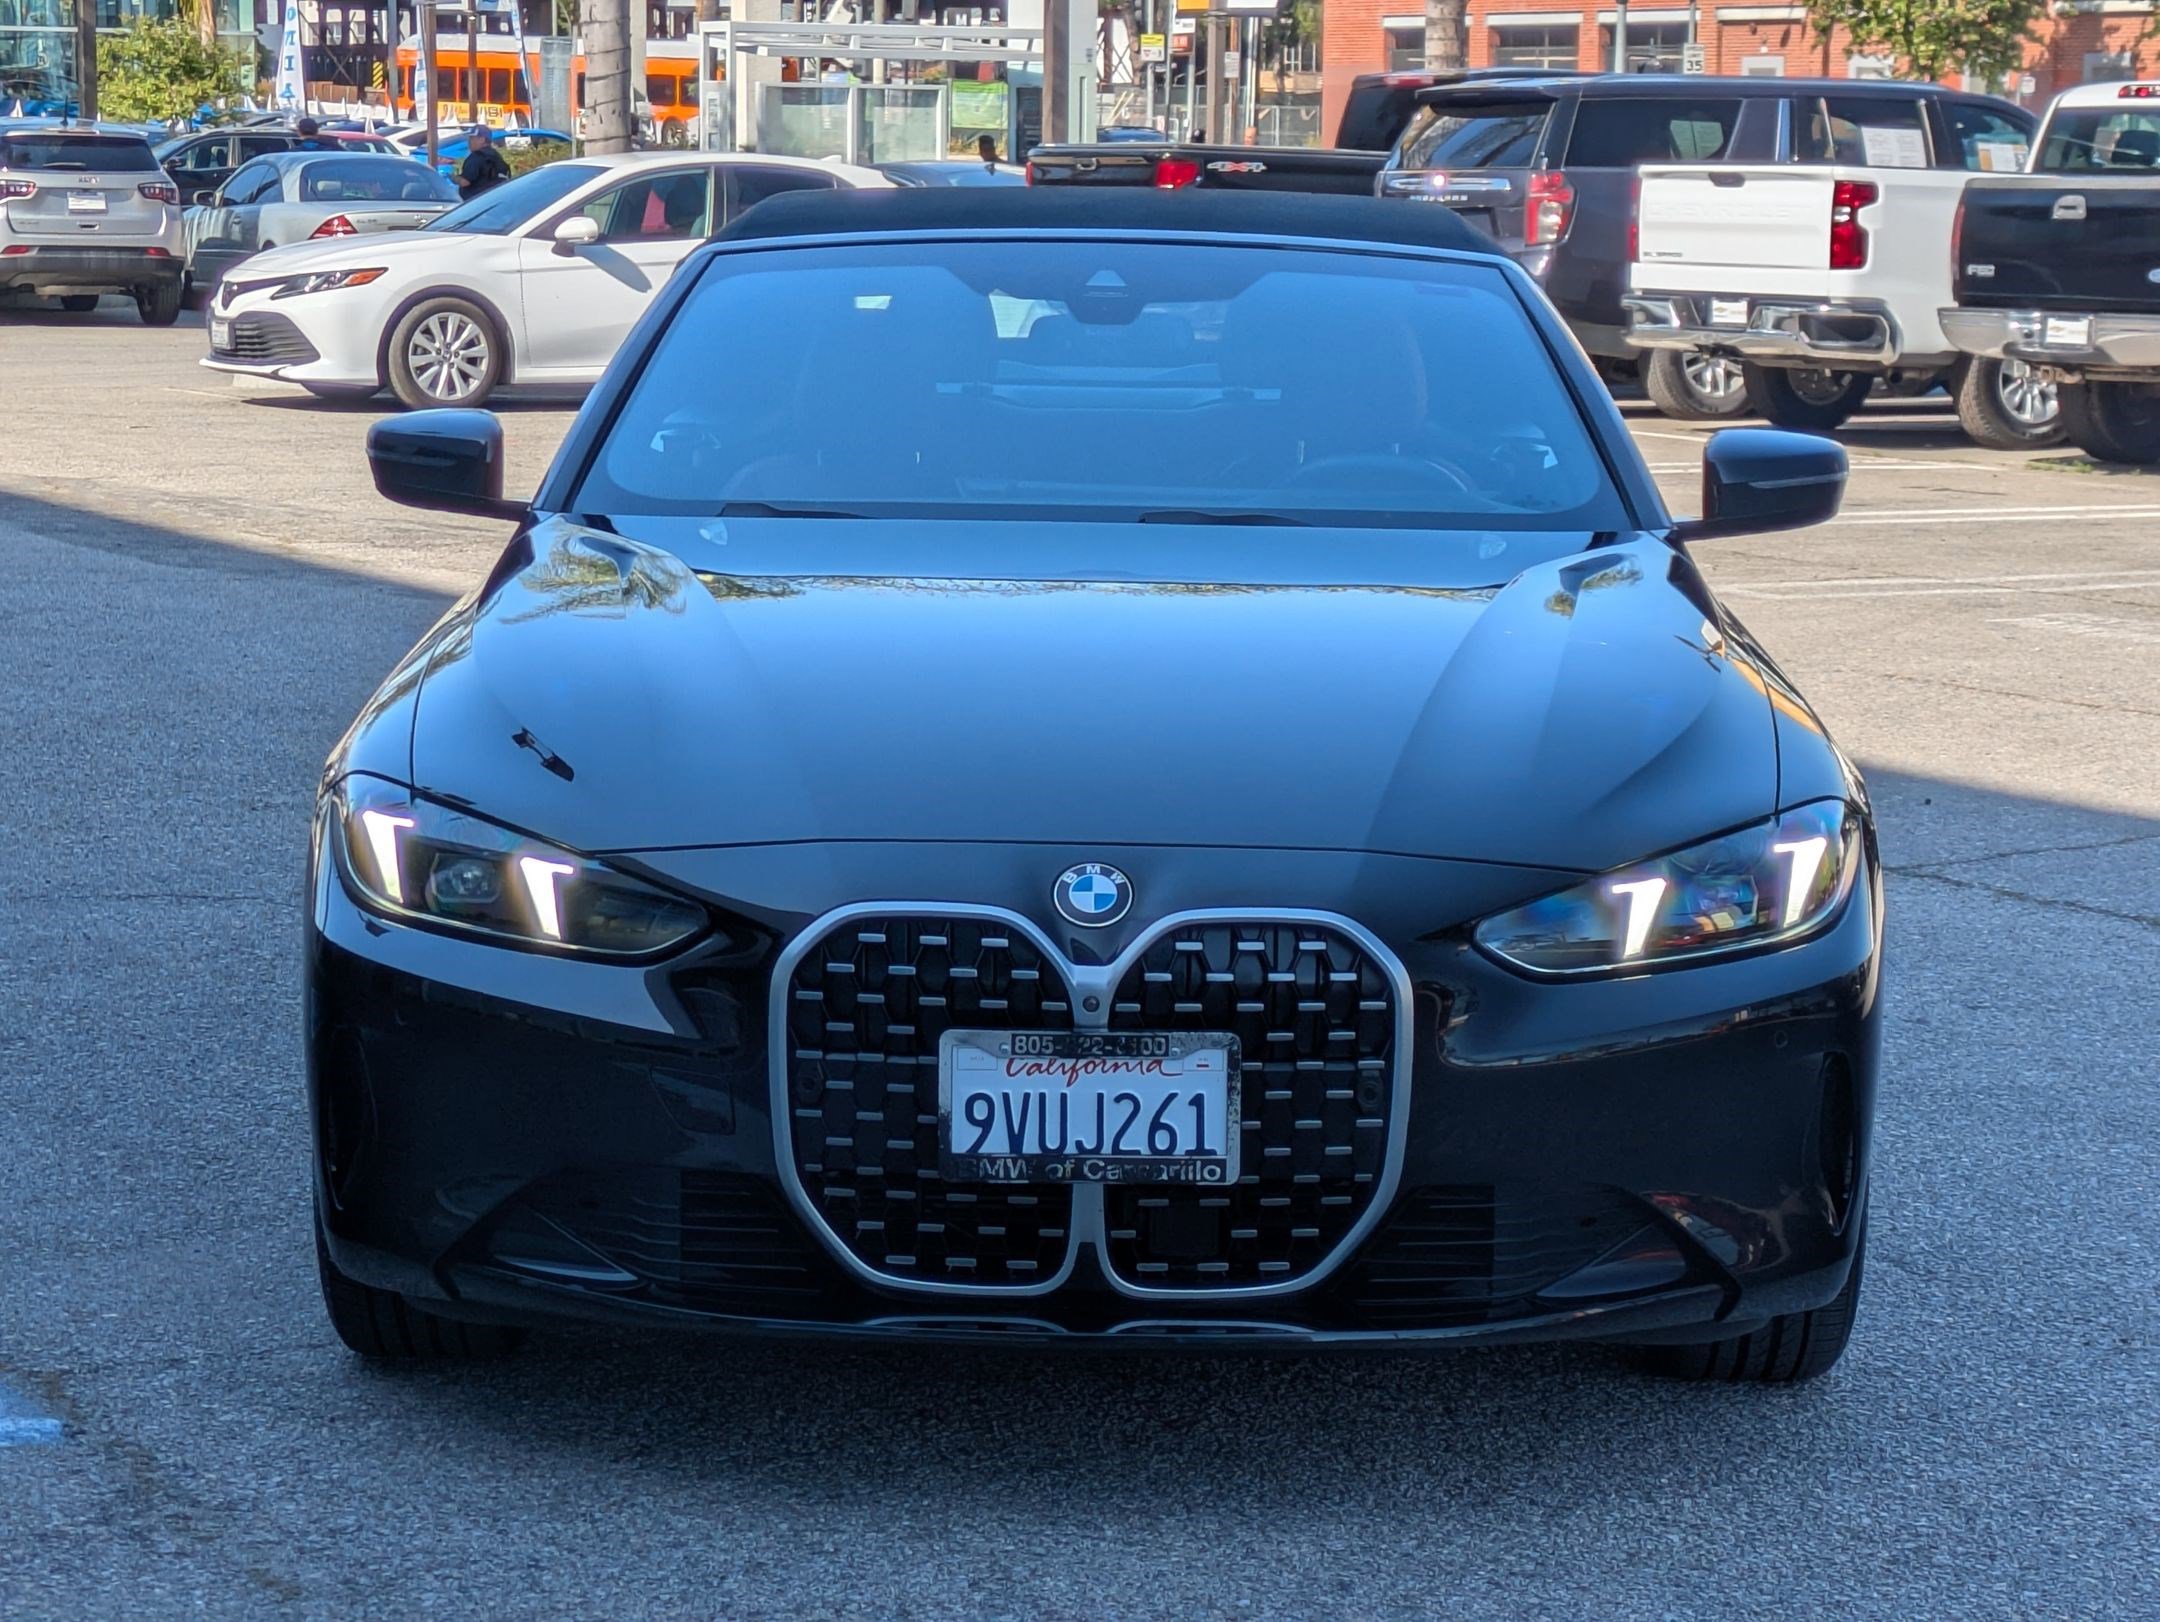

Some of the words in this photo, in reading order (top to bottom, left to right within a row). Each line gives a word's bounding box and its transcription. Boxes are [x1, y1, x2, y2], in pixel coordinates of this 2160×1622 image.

[1686, 60, 1702, 72] 35
[1062, 865, 1125, 885] BMW
[1006, 1056, 1183, 1087] California
[964, 1092, 1218, 1156] 9VUJ261
[1045, 1158, 1075, 1180] of
